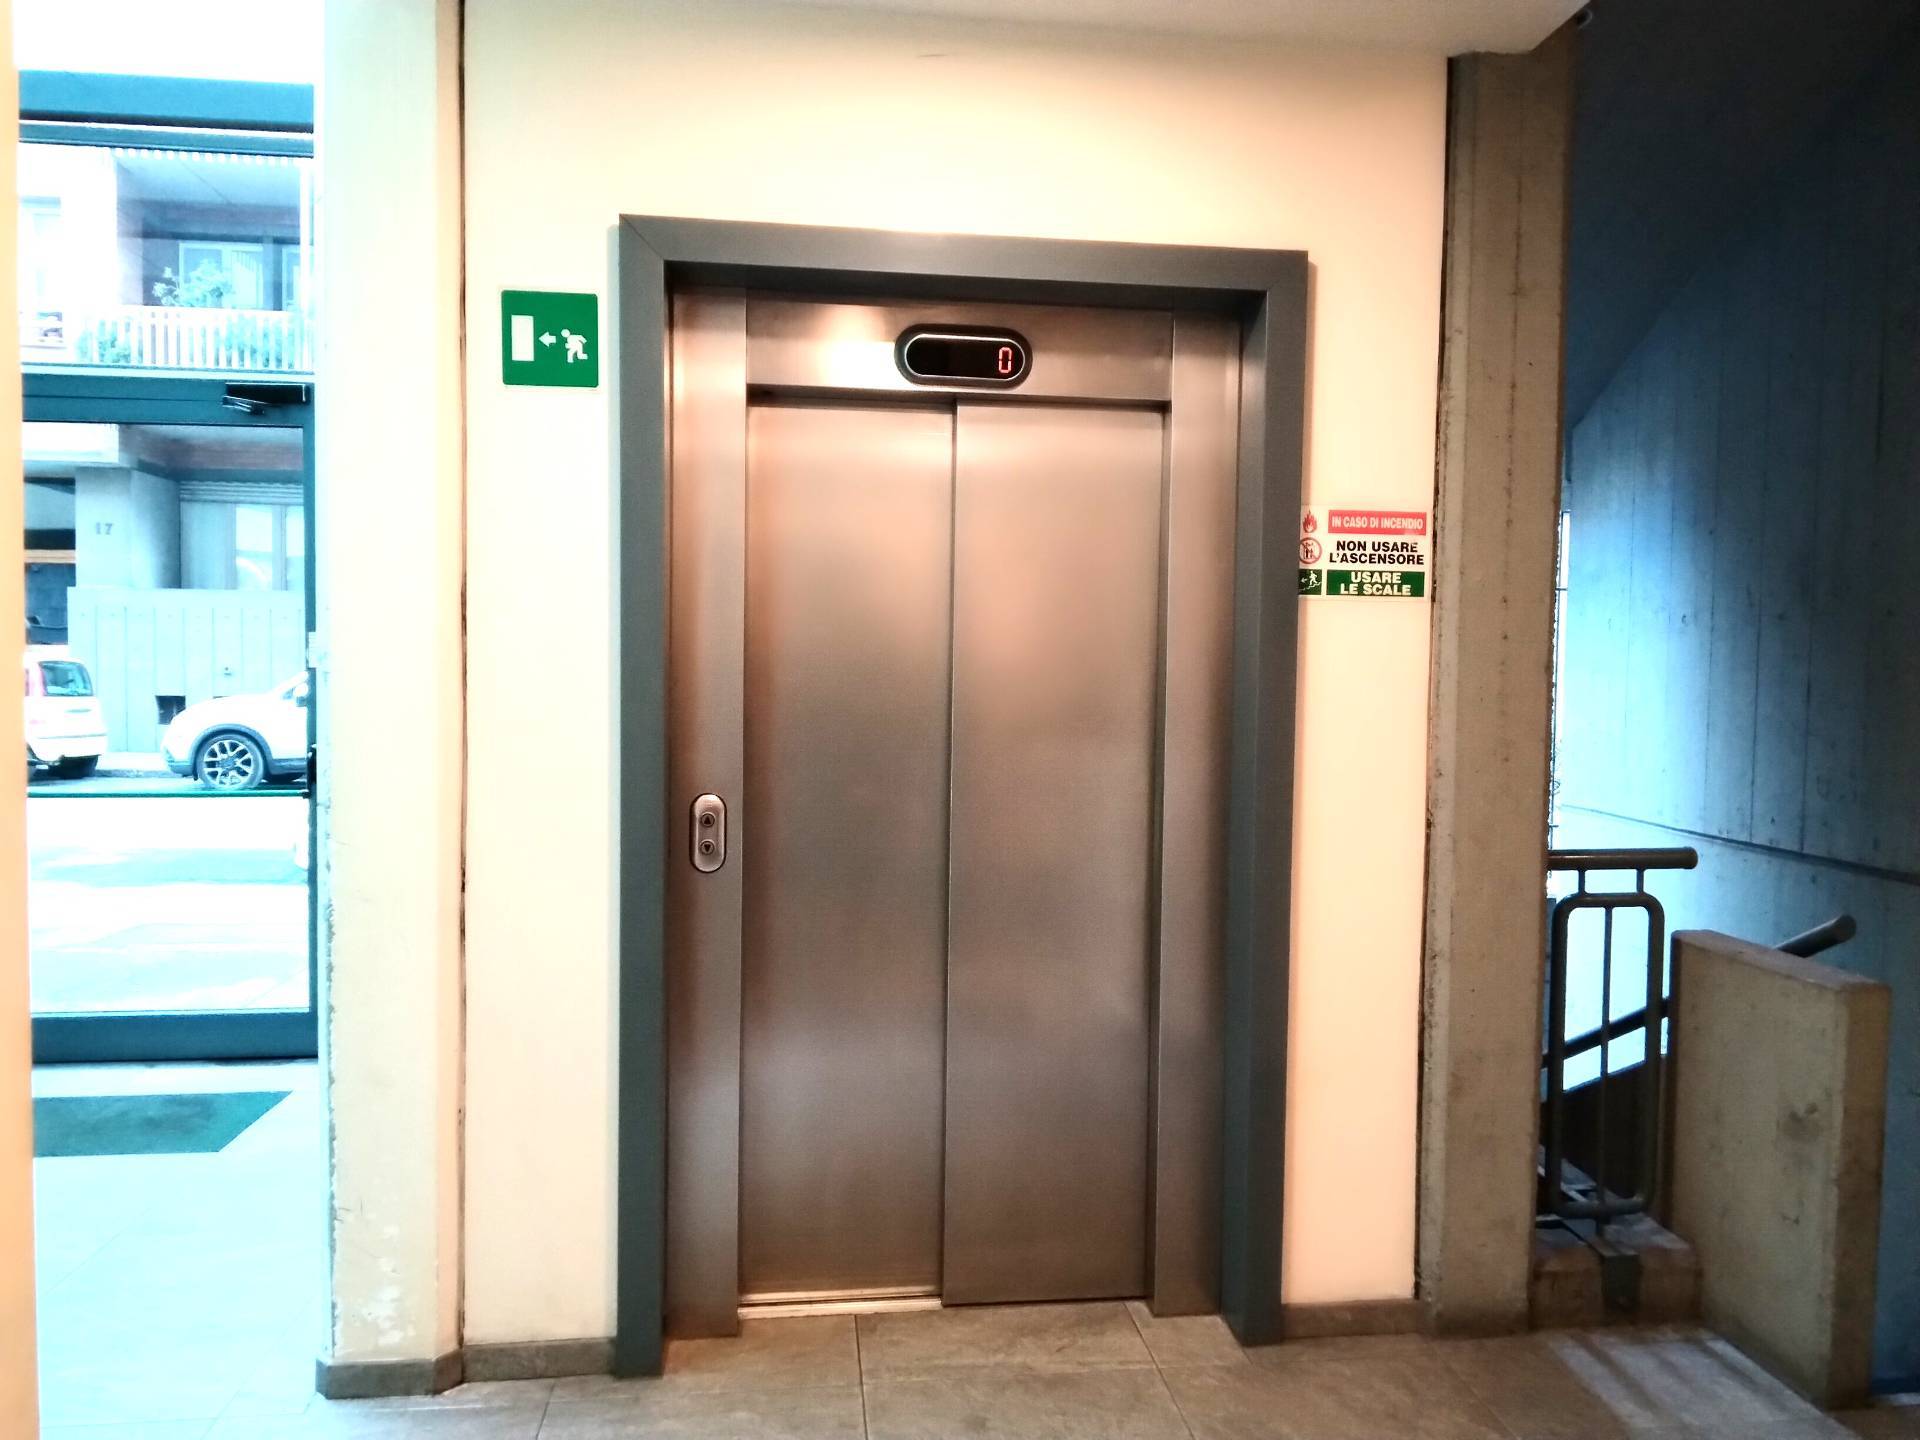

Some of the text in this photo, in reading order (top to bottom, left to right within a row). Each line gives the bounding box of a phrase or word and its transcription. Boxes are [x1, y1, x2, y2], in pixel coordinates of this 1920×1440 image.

[998, 346, 1012, 373] 0
[1332, 516, 1423, 529] IN CASO DI INCENDIO
[1336, 540, 1418, 553] NON USARE
[1329, 552, 1424, 565] L'ASCENSORE
[1350, 571, 1402, 584] USARE
[1339, 583, 1411, 596] LE SCALE
